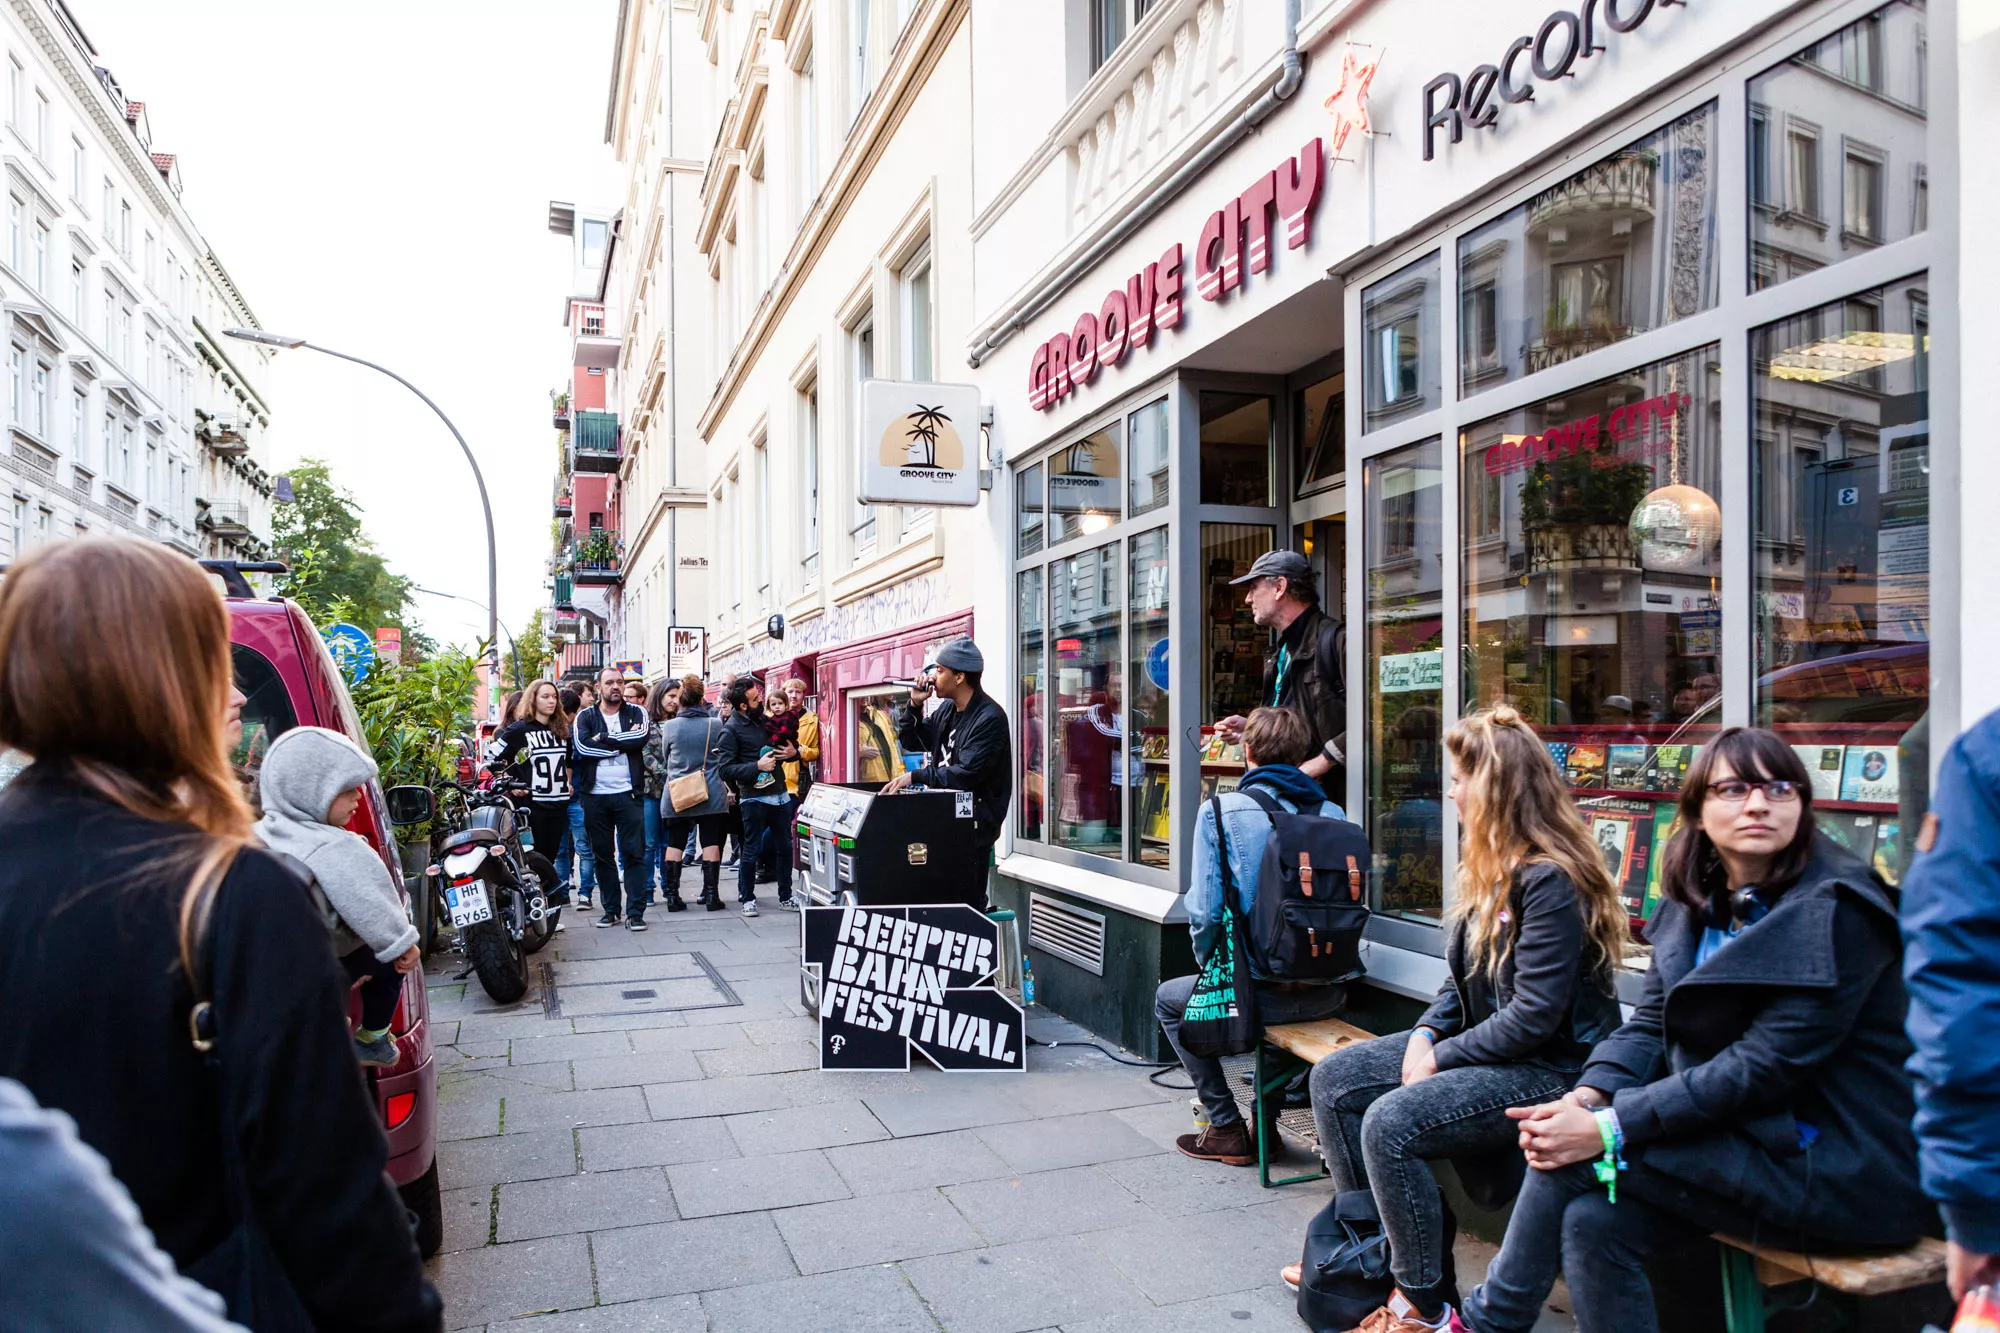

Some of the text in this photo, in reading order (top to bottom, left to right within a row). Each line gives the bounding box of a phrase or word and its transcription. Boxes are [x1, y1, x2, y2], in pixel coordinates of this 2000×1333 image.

[1028, 137, 1322, 411] GROOVE CITY
[1484, 391, 1678, 476] GROOVE CITY
[900, 470, 955, 480] GROOVE CITY
[534, 755, 569, 795] 94
[455, 907, 488, 926] EY 65
[461, 883, 479, 898] HH
[837, 908, 993, 976] REEPER
[828, 944, 950, 1006] BAHN
[822, 981, 1016, 1063] FESTIVAL
